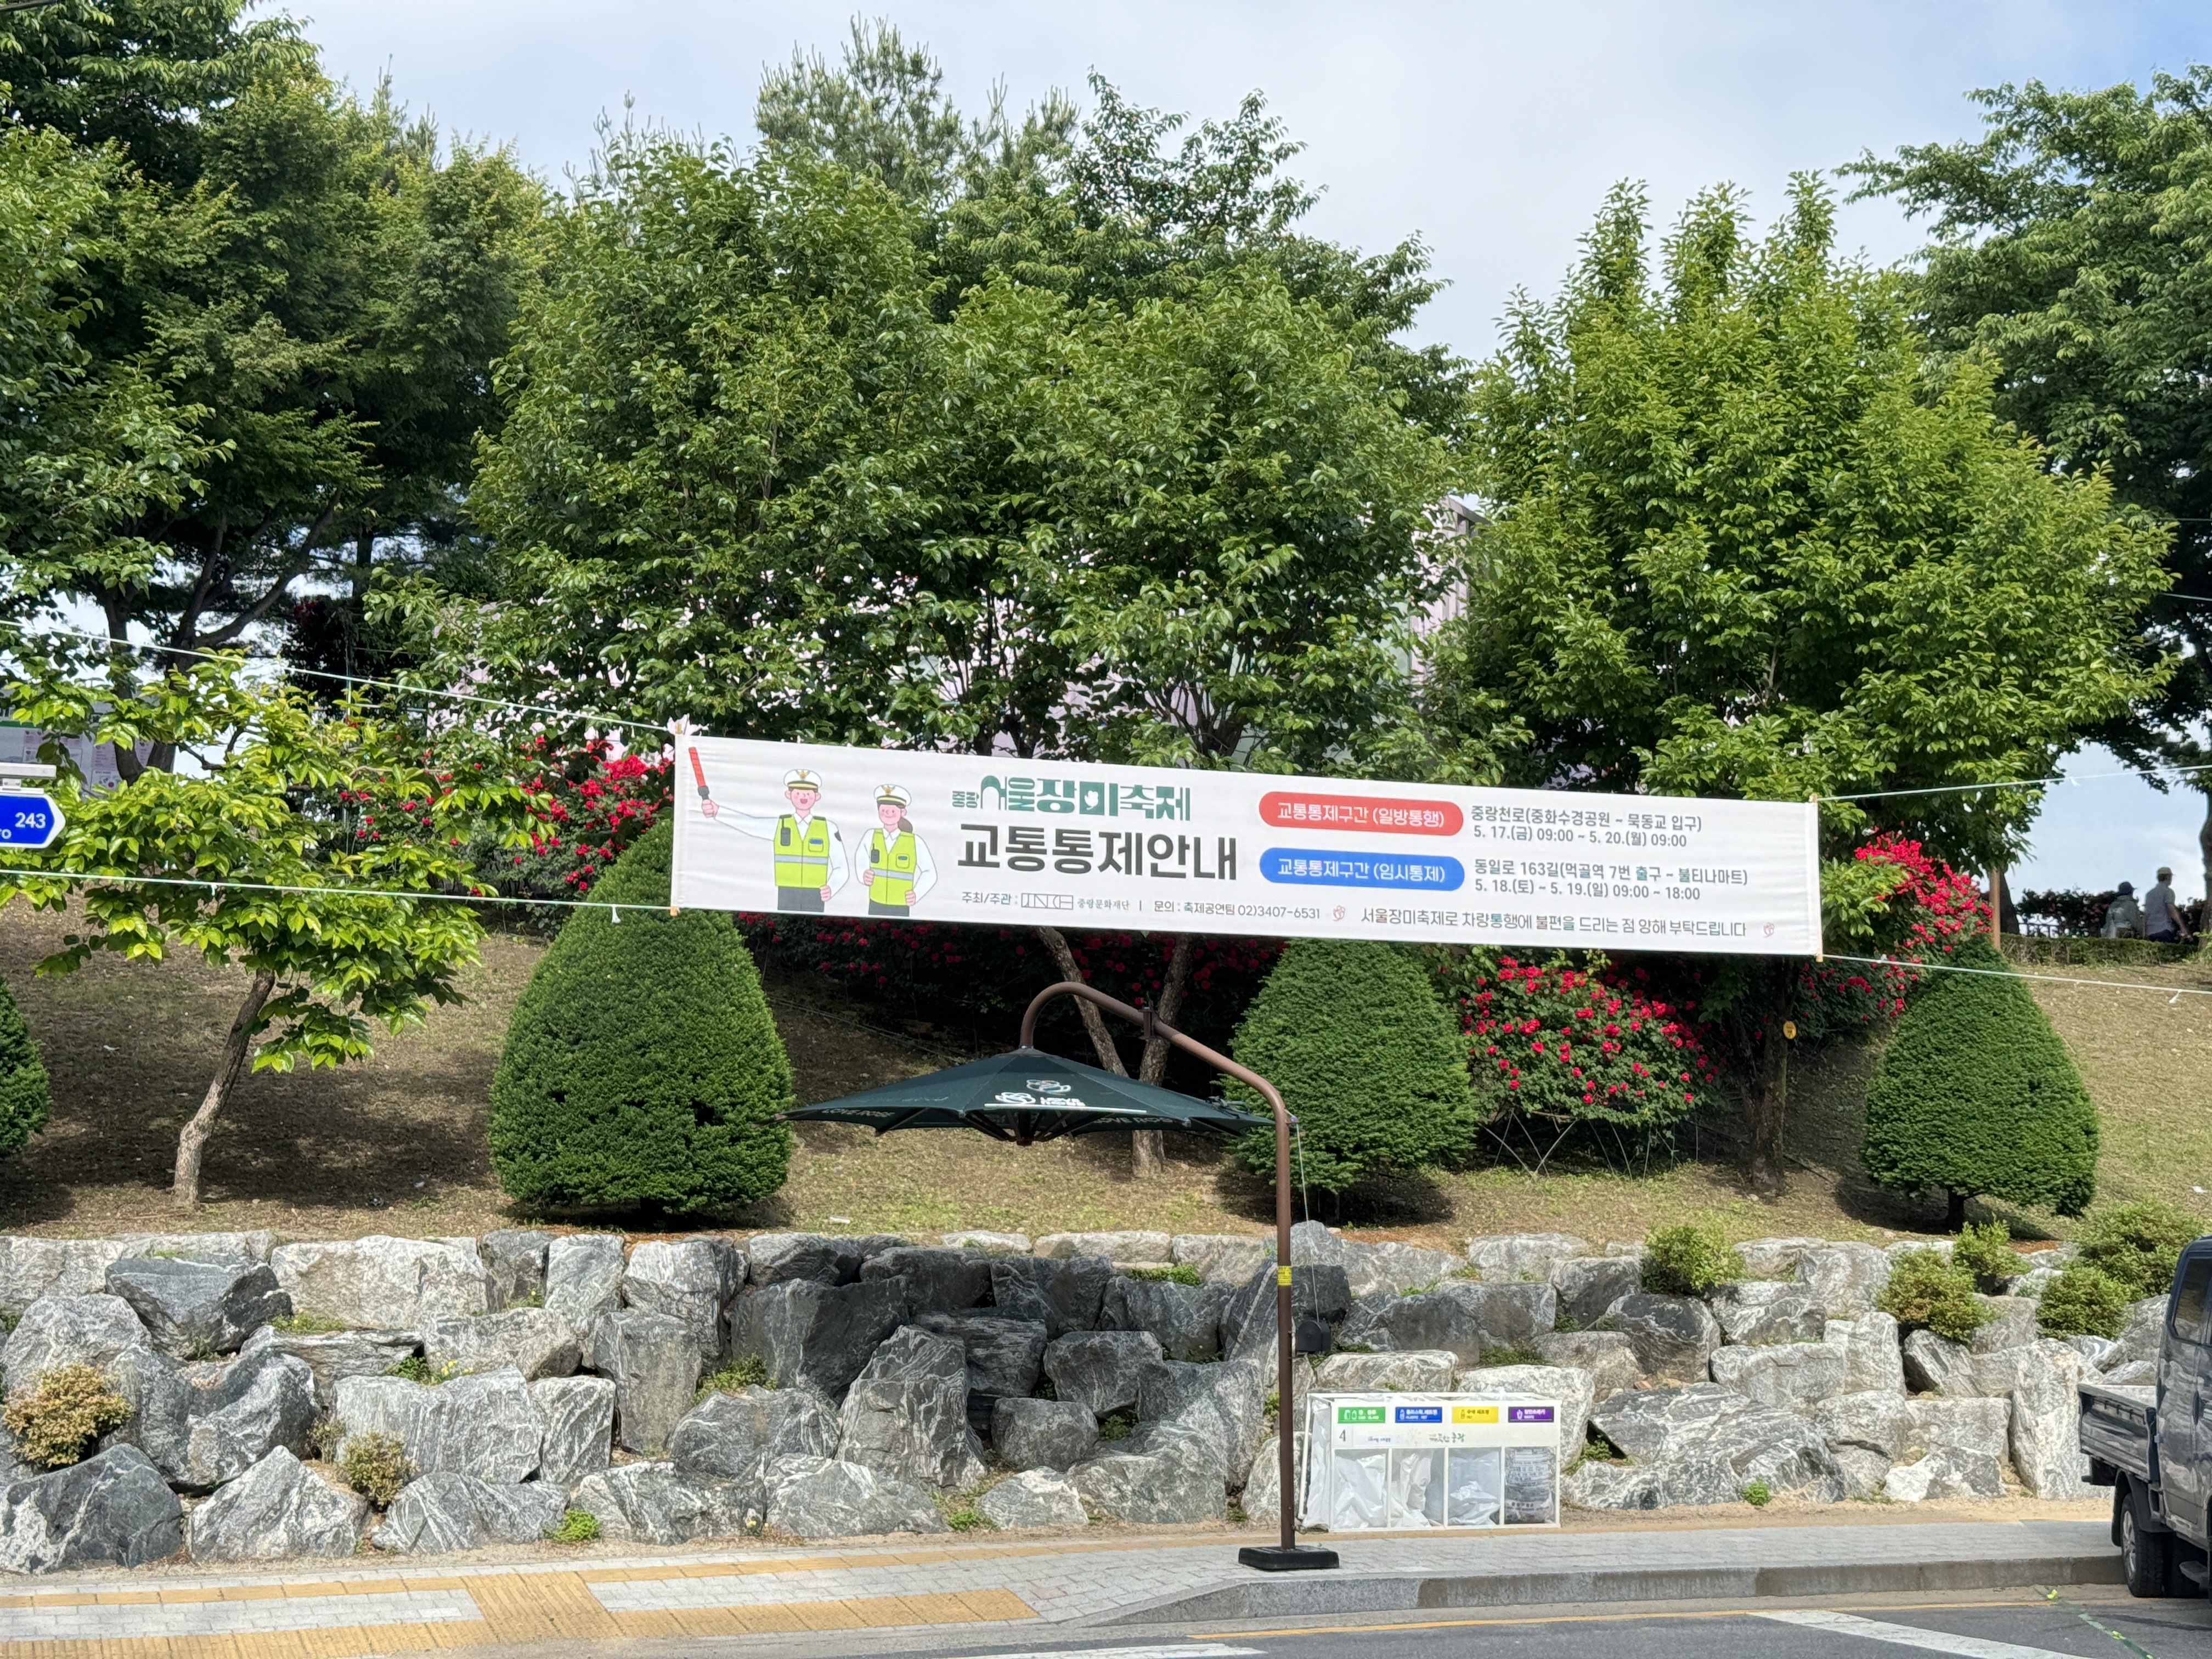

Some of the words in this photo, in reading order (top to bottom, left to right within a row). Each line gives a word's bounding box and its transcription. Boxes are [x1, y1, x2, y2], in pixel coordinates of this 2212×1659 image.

[980, 775, 1190, 821] 서울장미축제
[15, 812, 46, 828] 243
[1277, 802, 1369, 822] 교통통제구간
[1373, 808, 1444, 827] (일방통행)
[1471, 805, 1610, 827] 중랑천로(중화수경공원
[1628, 813, 1666, 830] 묵동교
[1671, 815, 1702, 832] 입구)
[1474, 825, 1486, 838] 5.
[1491, 826, 1533, 842] 17.(금)
[1537, 828, 1573, 842] 09:00
[1589, 831, 1601, 844] 5.
[1605, 832, 1647, 847] 20.(월)
[1651, 833, 1687, 847] 09:00
[958, 823, 1237, 880] 교통통제안내
[1277, 858, 1369, 879] 교통통제구간
[1374, 863, 1446, 883] (임시통제)
[1474, 859, 1515, 876] 동일로
[1520, 862, 1604, 879] 163길(먹골역
[1609, 865, 1630, 881] 7번
[1636, 866, 1661, 882] 출구
[1679, 867, 1748, 885] 불티나마트)
[962, 891, 1012, 905] 주최/주관
[1475, 878, 1487, 892] 5.
[1492, 879, 1534, 894] 18.(토)
[1550, 884, 1562, 895] 5.
[1567, 884, 1609, 898] 19.(일)
[1613, 885, 1649, 899] 09:00
[1665, 887, 1701, 900] 18:00
[1154, 900, 1174, 912] 문의
[1184, 901, 1235, 916] 축제공연팀
[1238, 904, 1321, 919] 02)3407-6531
[1361, 907, 1458, 927] 서울장미축제로
[1462, 911, 1532, 929] 차량통행에
[1536, 915, 1575, 932] 불편을
[1579, 916, 1618, 933] 드리는
[1622, 918, 1635, 933] 점
[1638, 918, 1666, 935] 양해
[1669, 919, 1746, 937] 부탁드립니다
[1339, 1429, 1346, 1442] 4
